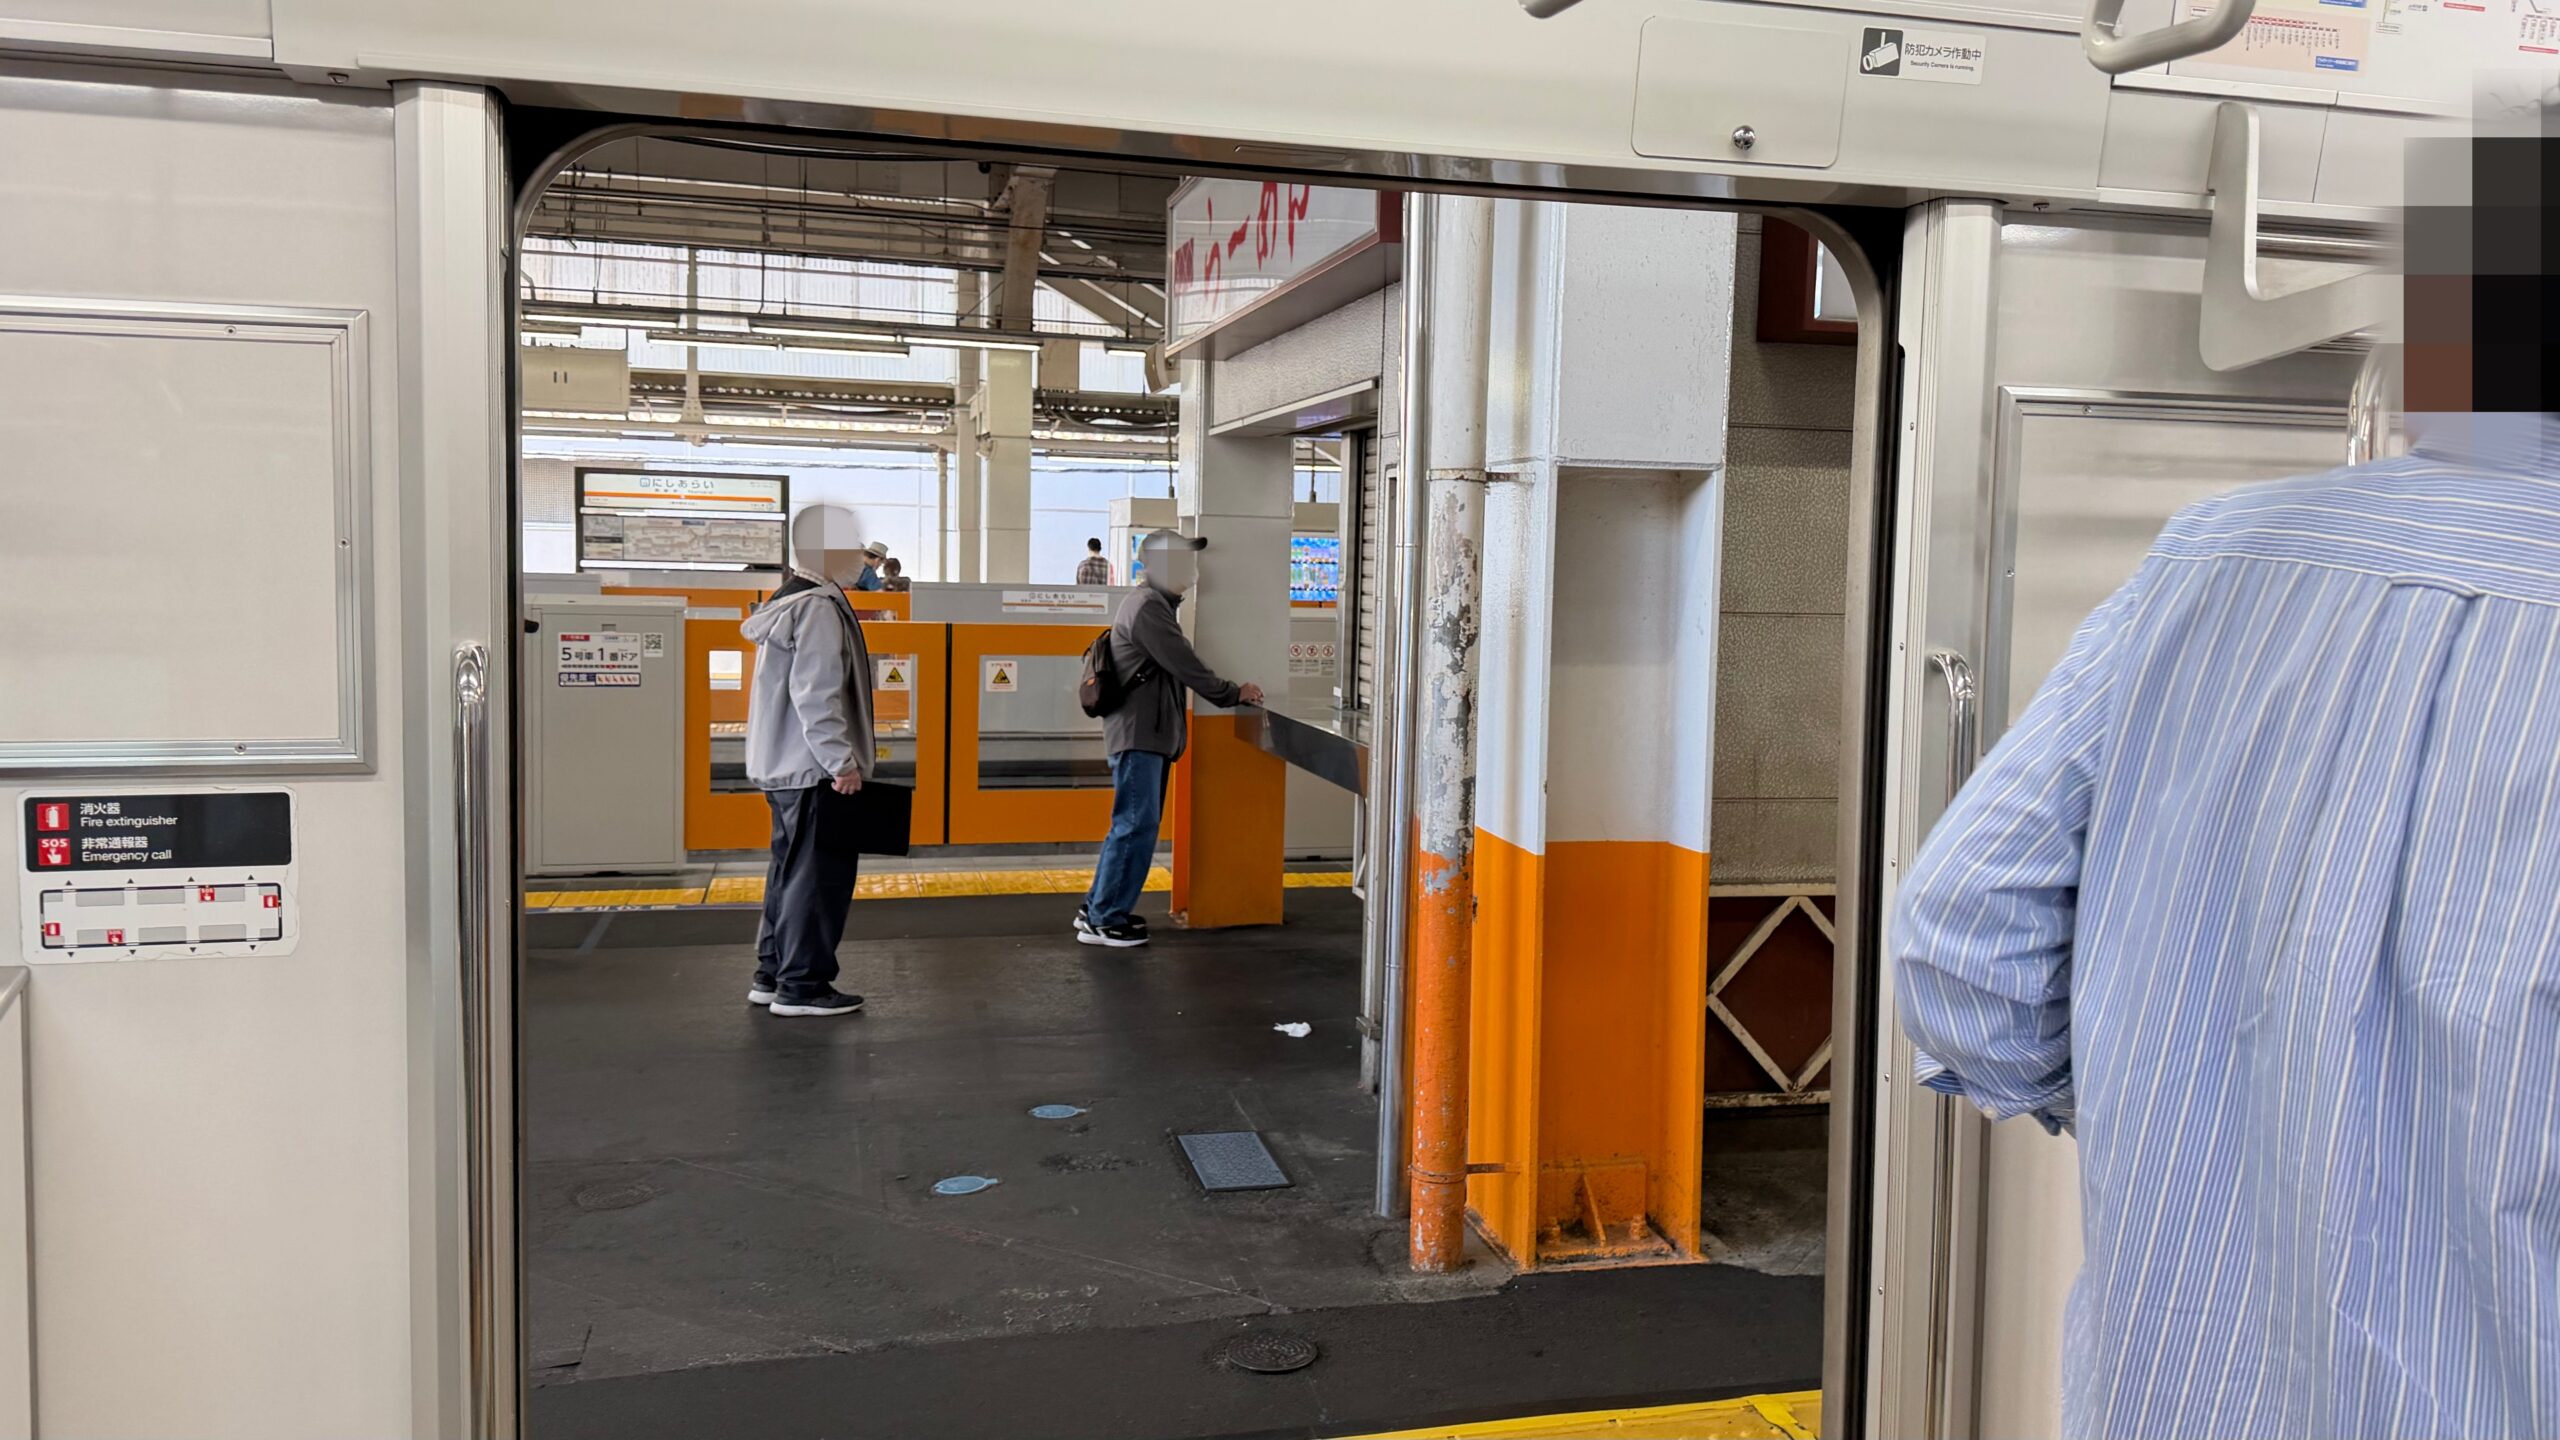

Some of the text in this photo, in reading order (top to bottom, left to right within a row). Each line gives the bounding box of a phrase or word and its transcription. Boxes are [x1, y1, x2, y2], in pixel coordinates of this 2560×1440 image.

[1904, 43, 1982, 61] 防犯カメラ作動中
[1910, 60, 1930, 68] Security
[652, 478, 714, 489] にしあらい
[80, 802, 120, 815] 消火器
[80, 815, 178, 828] Fire extinguisher
[41, 838, 68, 848] SOS
[81, 836, 149, 849] 非常通報器
[82, 849, 172, 863] Emergency call
